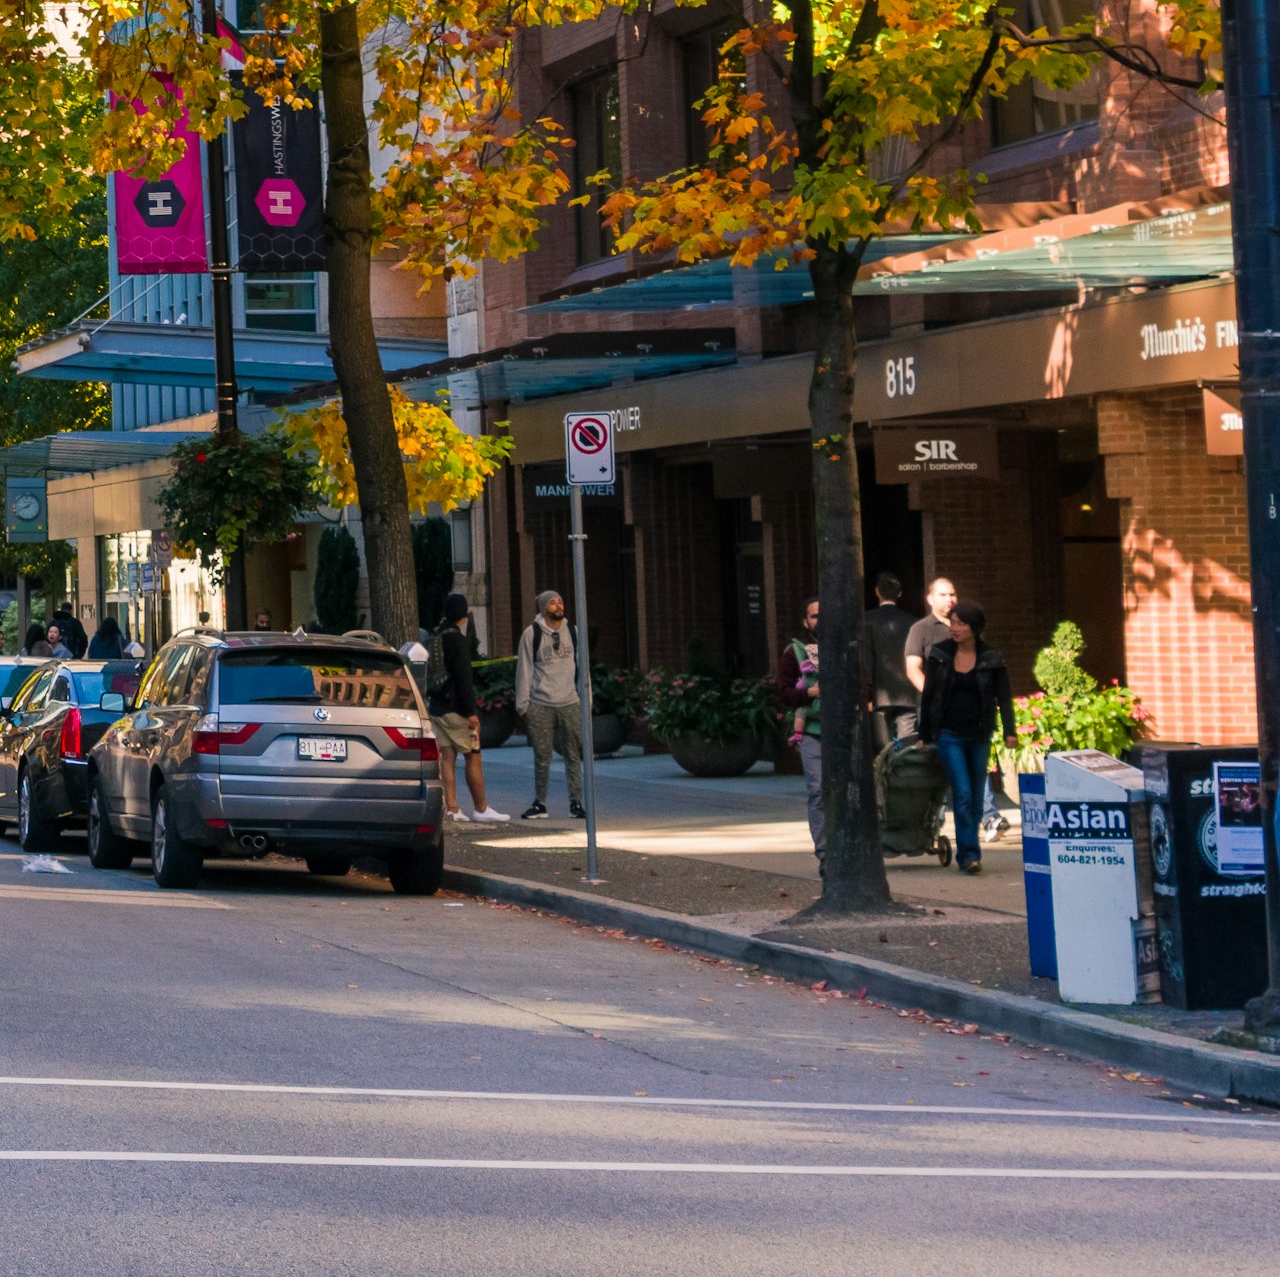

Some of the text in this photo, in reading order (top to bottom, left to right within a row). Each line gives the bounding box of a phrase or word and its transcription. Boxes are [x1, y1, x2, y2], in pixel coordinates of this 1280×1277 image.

[269, 95, 284, 175] HASTINGSWES
[1141, 317, 1206, 361] Murchie's
[886, 357, 915, 398] 815
[915, 440, 958, 461] SIR
[898, 462, 977, 471] salon barbershop
[1047, 803, 1126, 828] Asian
[1058, 855, 1125, 865] 604-821-1954
